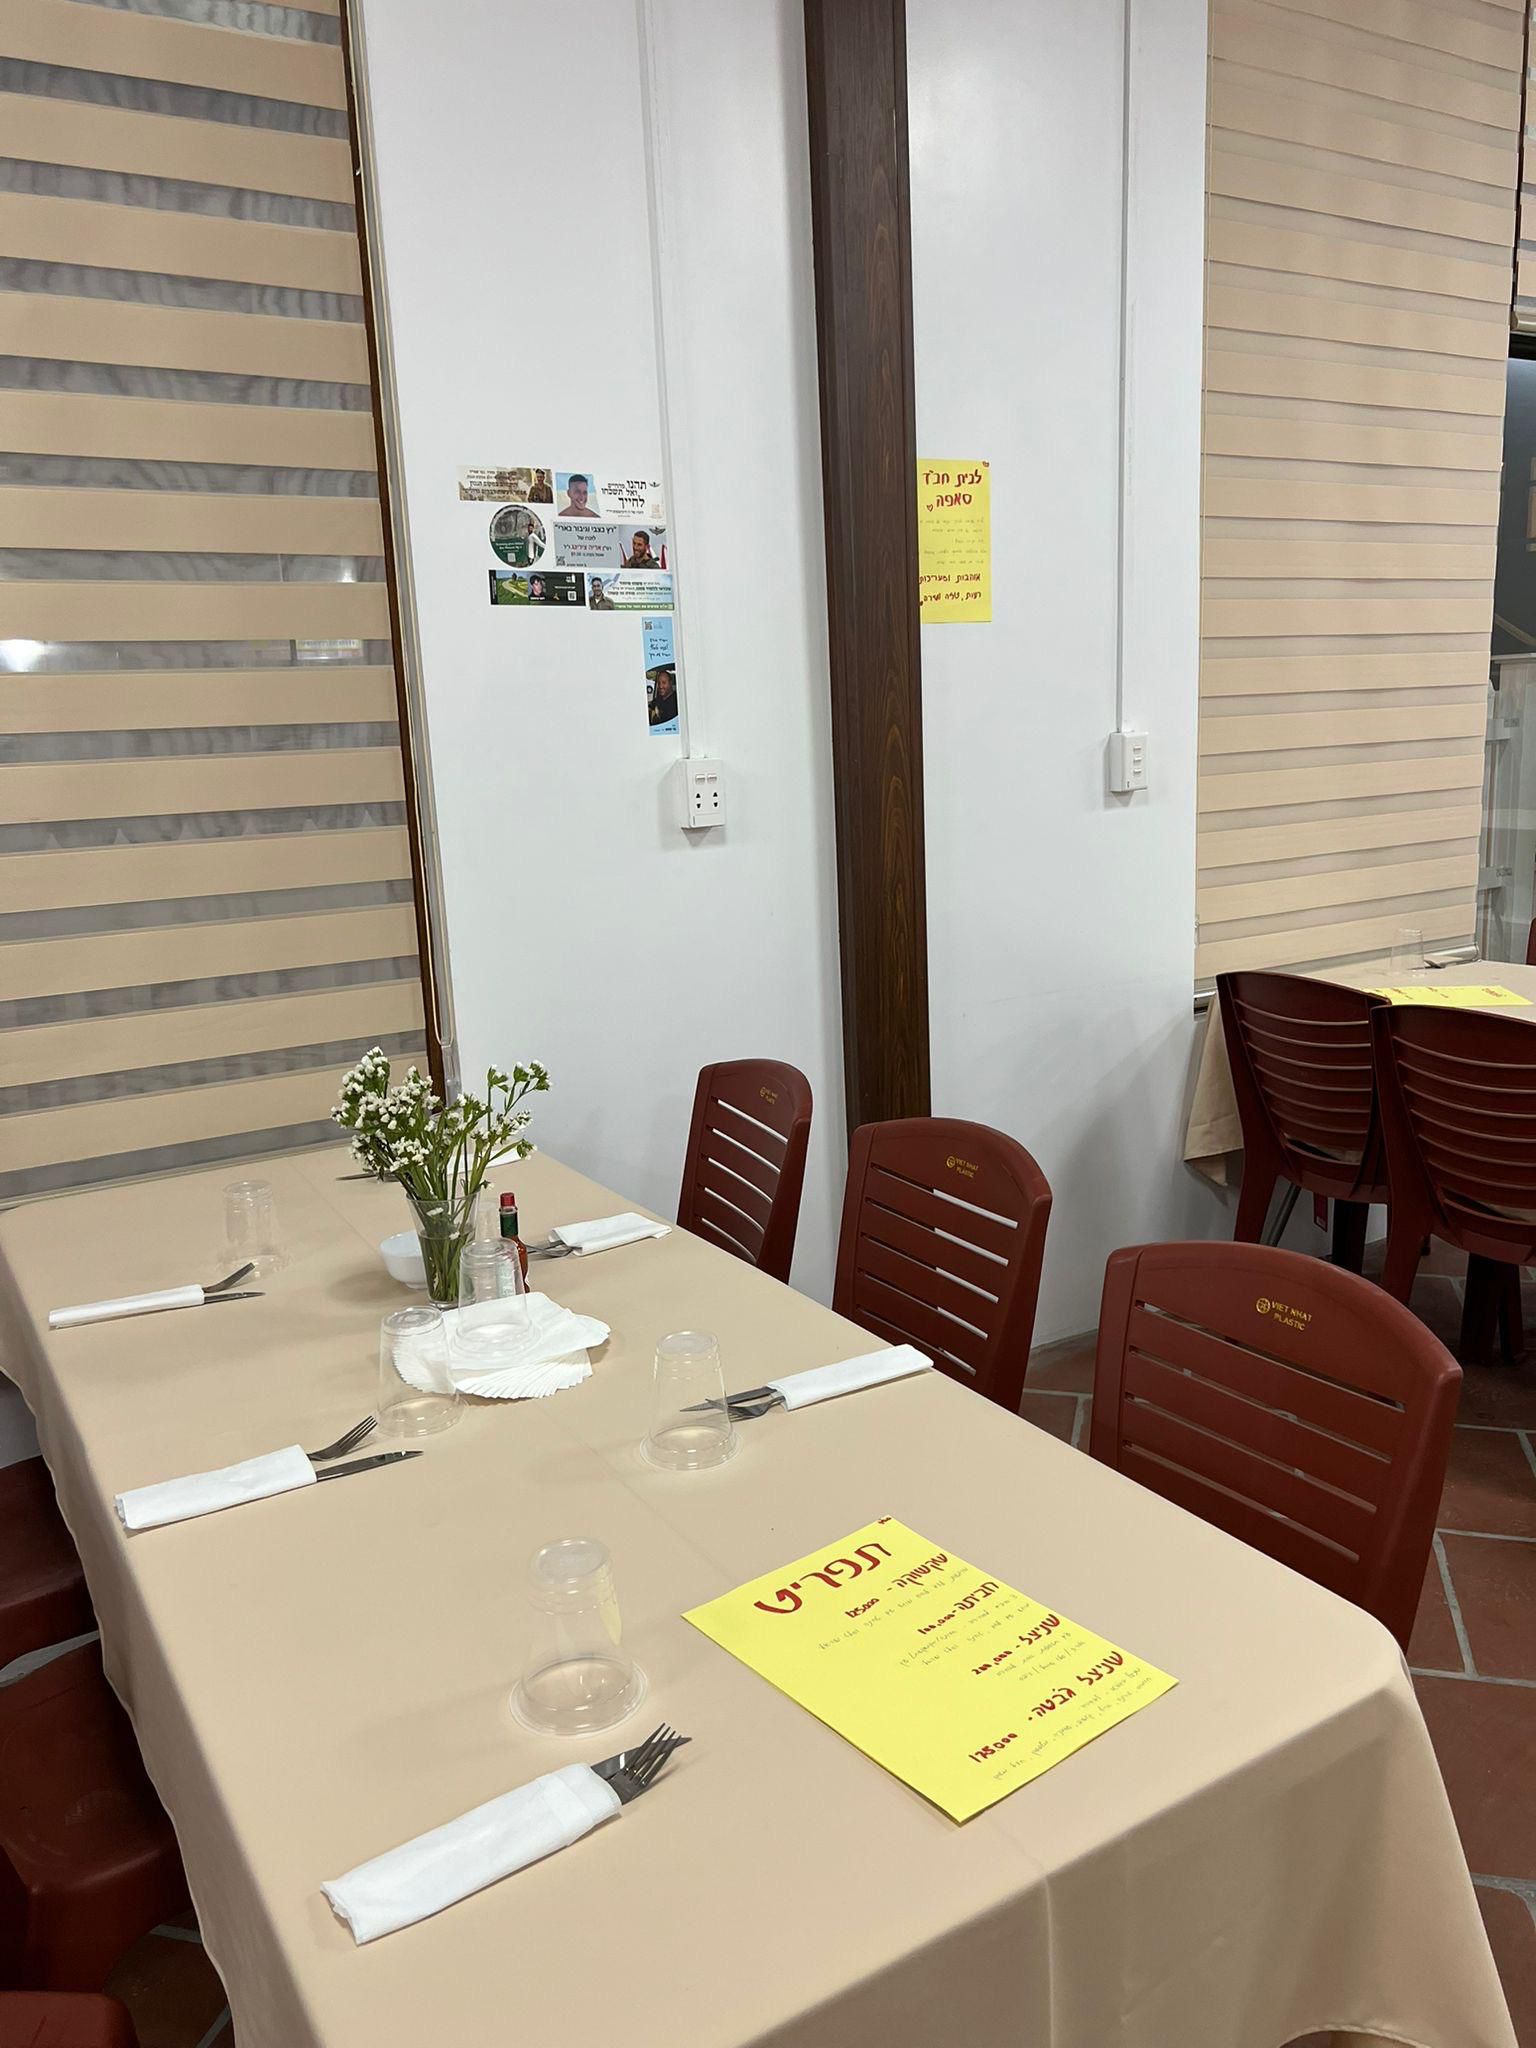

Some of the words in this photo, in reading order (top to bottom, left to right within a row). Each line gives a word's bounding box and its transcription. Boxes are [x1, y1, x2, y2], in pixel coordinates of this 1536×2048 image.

[626, 480, 647, 490] תהנו
[954, 469, 982, 487] לבית
[618, 495, 646, 509] לחייך
[936, 493, 972, 508] סאפה
[1272, 1301, 1288, 1312] VIET
[1274, 1313, 1305, 1331] PLASTIC
[754, 1543, 892, 1614] תפריט
[892, 1553, 948, 1588] שקשוקה
[954, 1582, 999, 1610] חביתה
[1019, 1614, 1060, 1645] שניצל
[1076, 1651, 1123, 1685] שניצל
